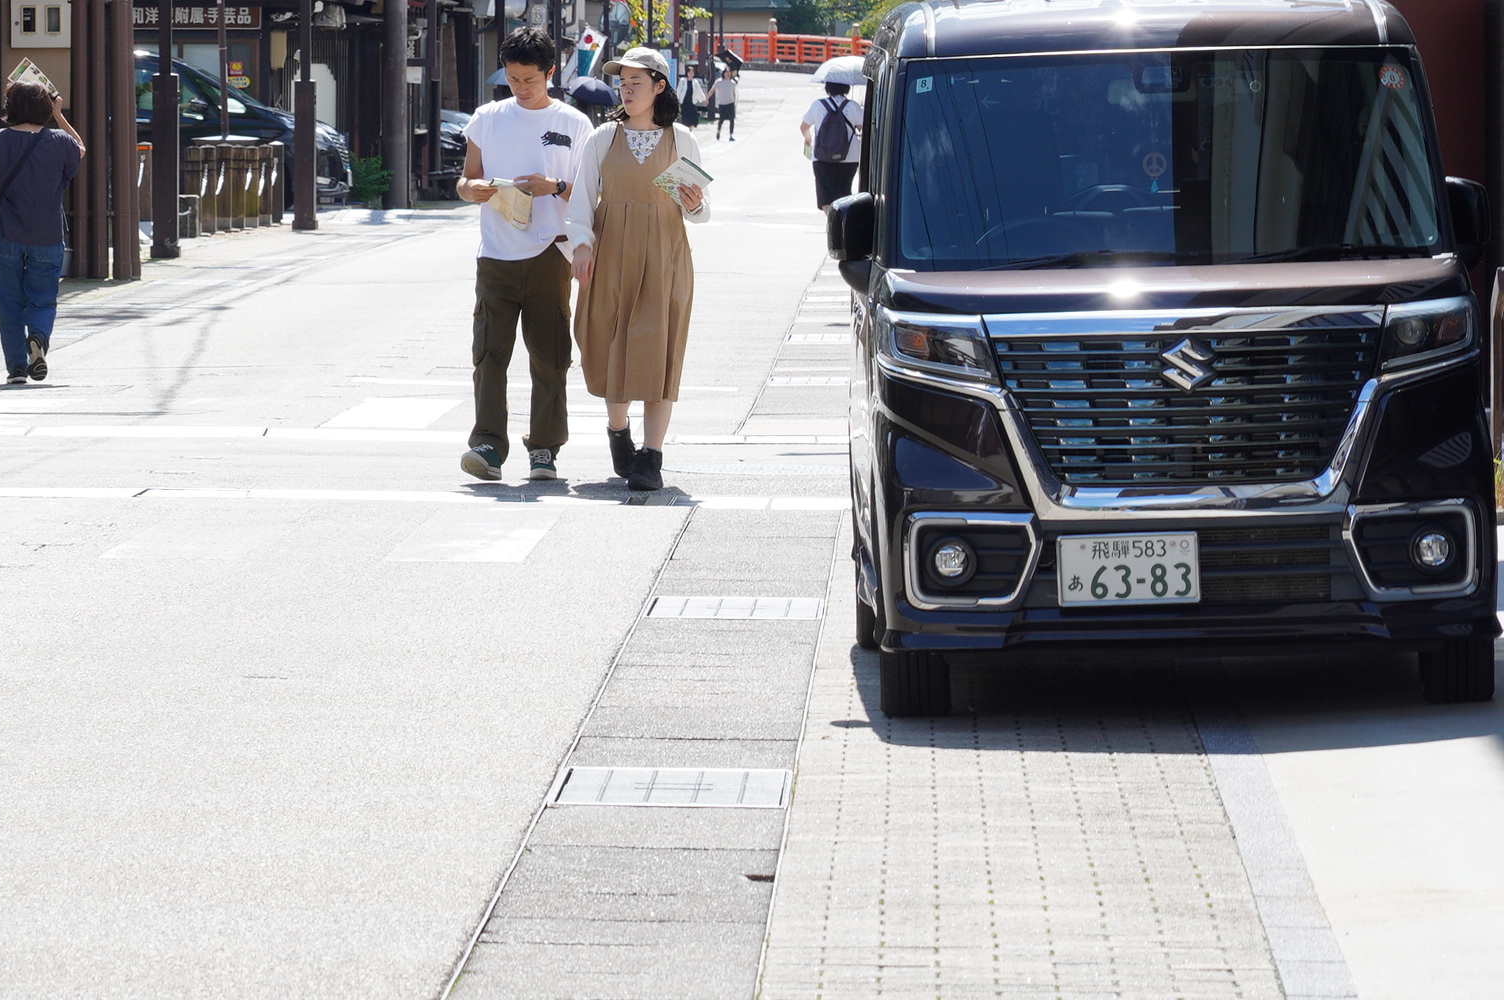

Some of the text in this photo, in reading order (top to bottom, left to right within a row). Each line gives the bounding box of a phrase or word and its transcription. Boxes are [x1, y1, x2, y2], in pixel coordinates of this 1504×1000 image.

[132, 6, 252, 25] 和洋附属・手芸品
[1132, 539, 1167, 558] 583
[1067, 562, 1193, 600] あ 63-83
